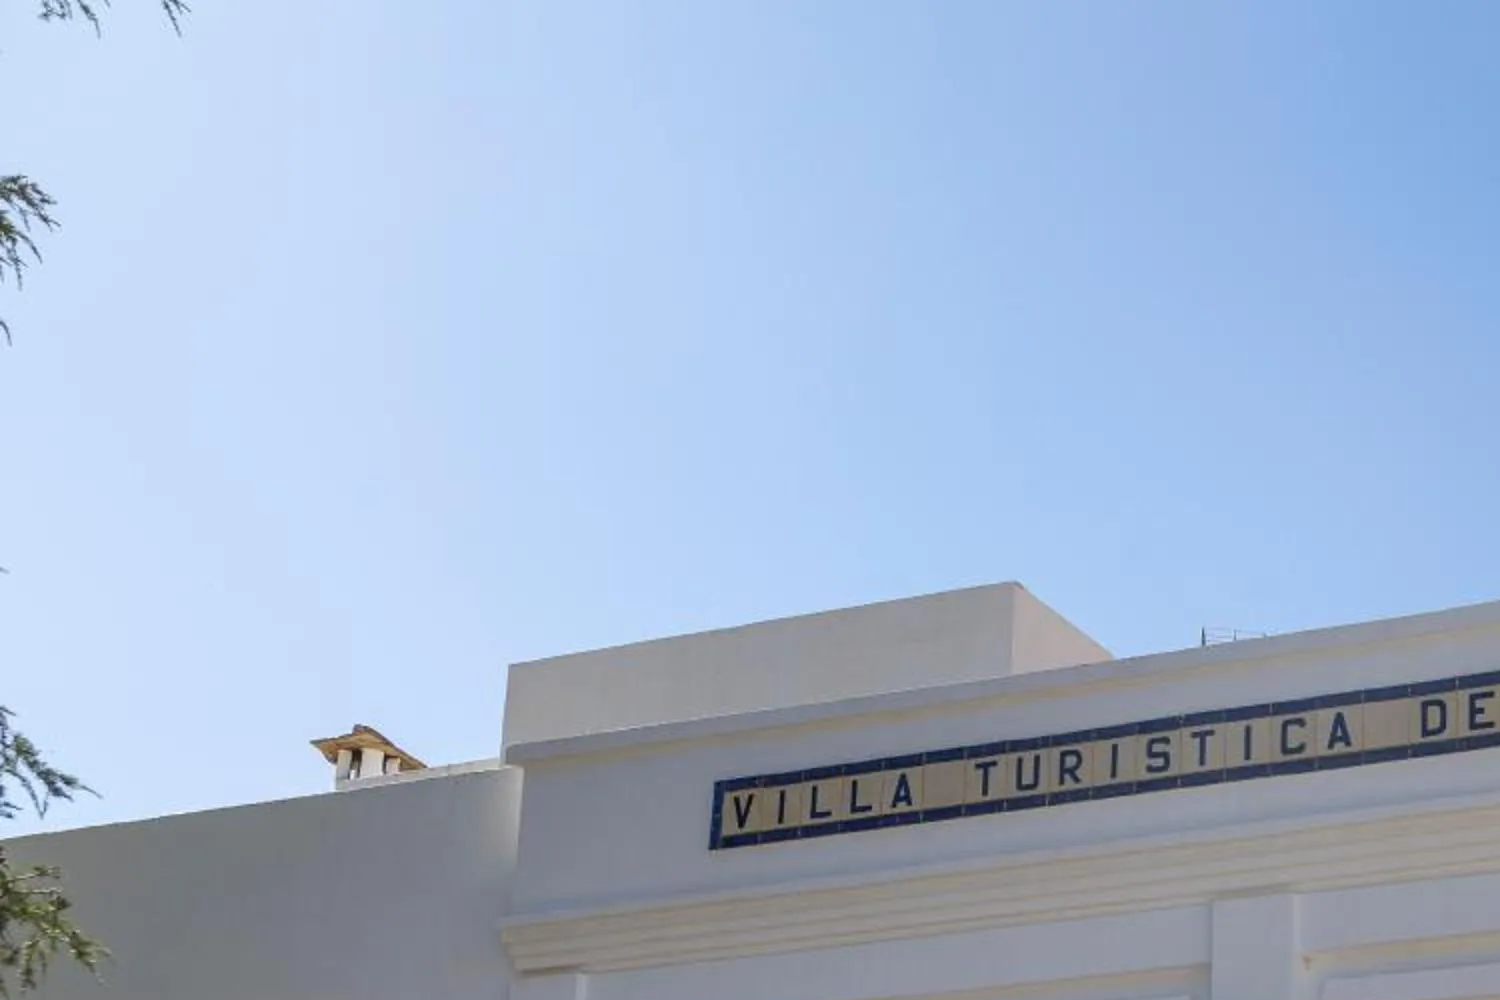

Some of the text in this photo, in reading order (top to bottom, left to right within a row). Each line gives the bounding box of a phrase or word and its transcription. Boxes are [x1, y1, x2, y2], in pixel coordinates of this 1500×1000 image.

[733, 773, 914, 829] VILLA
[975, 711, 1353, 796] TURISTICA
[1421, 691, 1496, 738] DE
